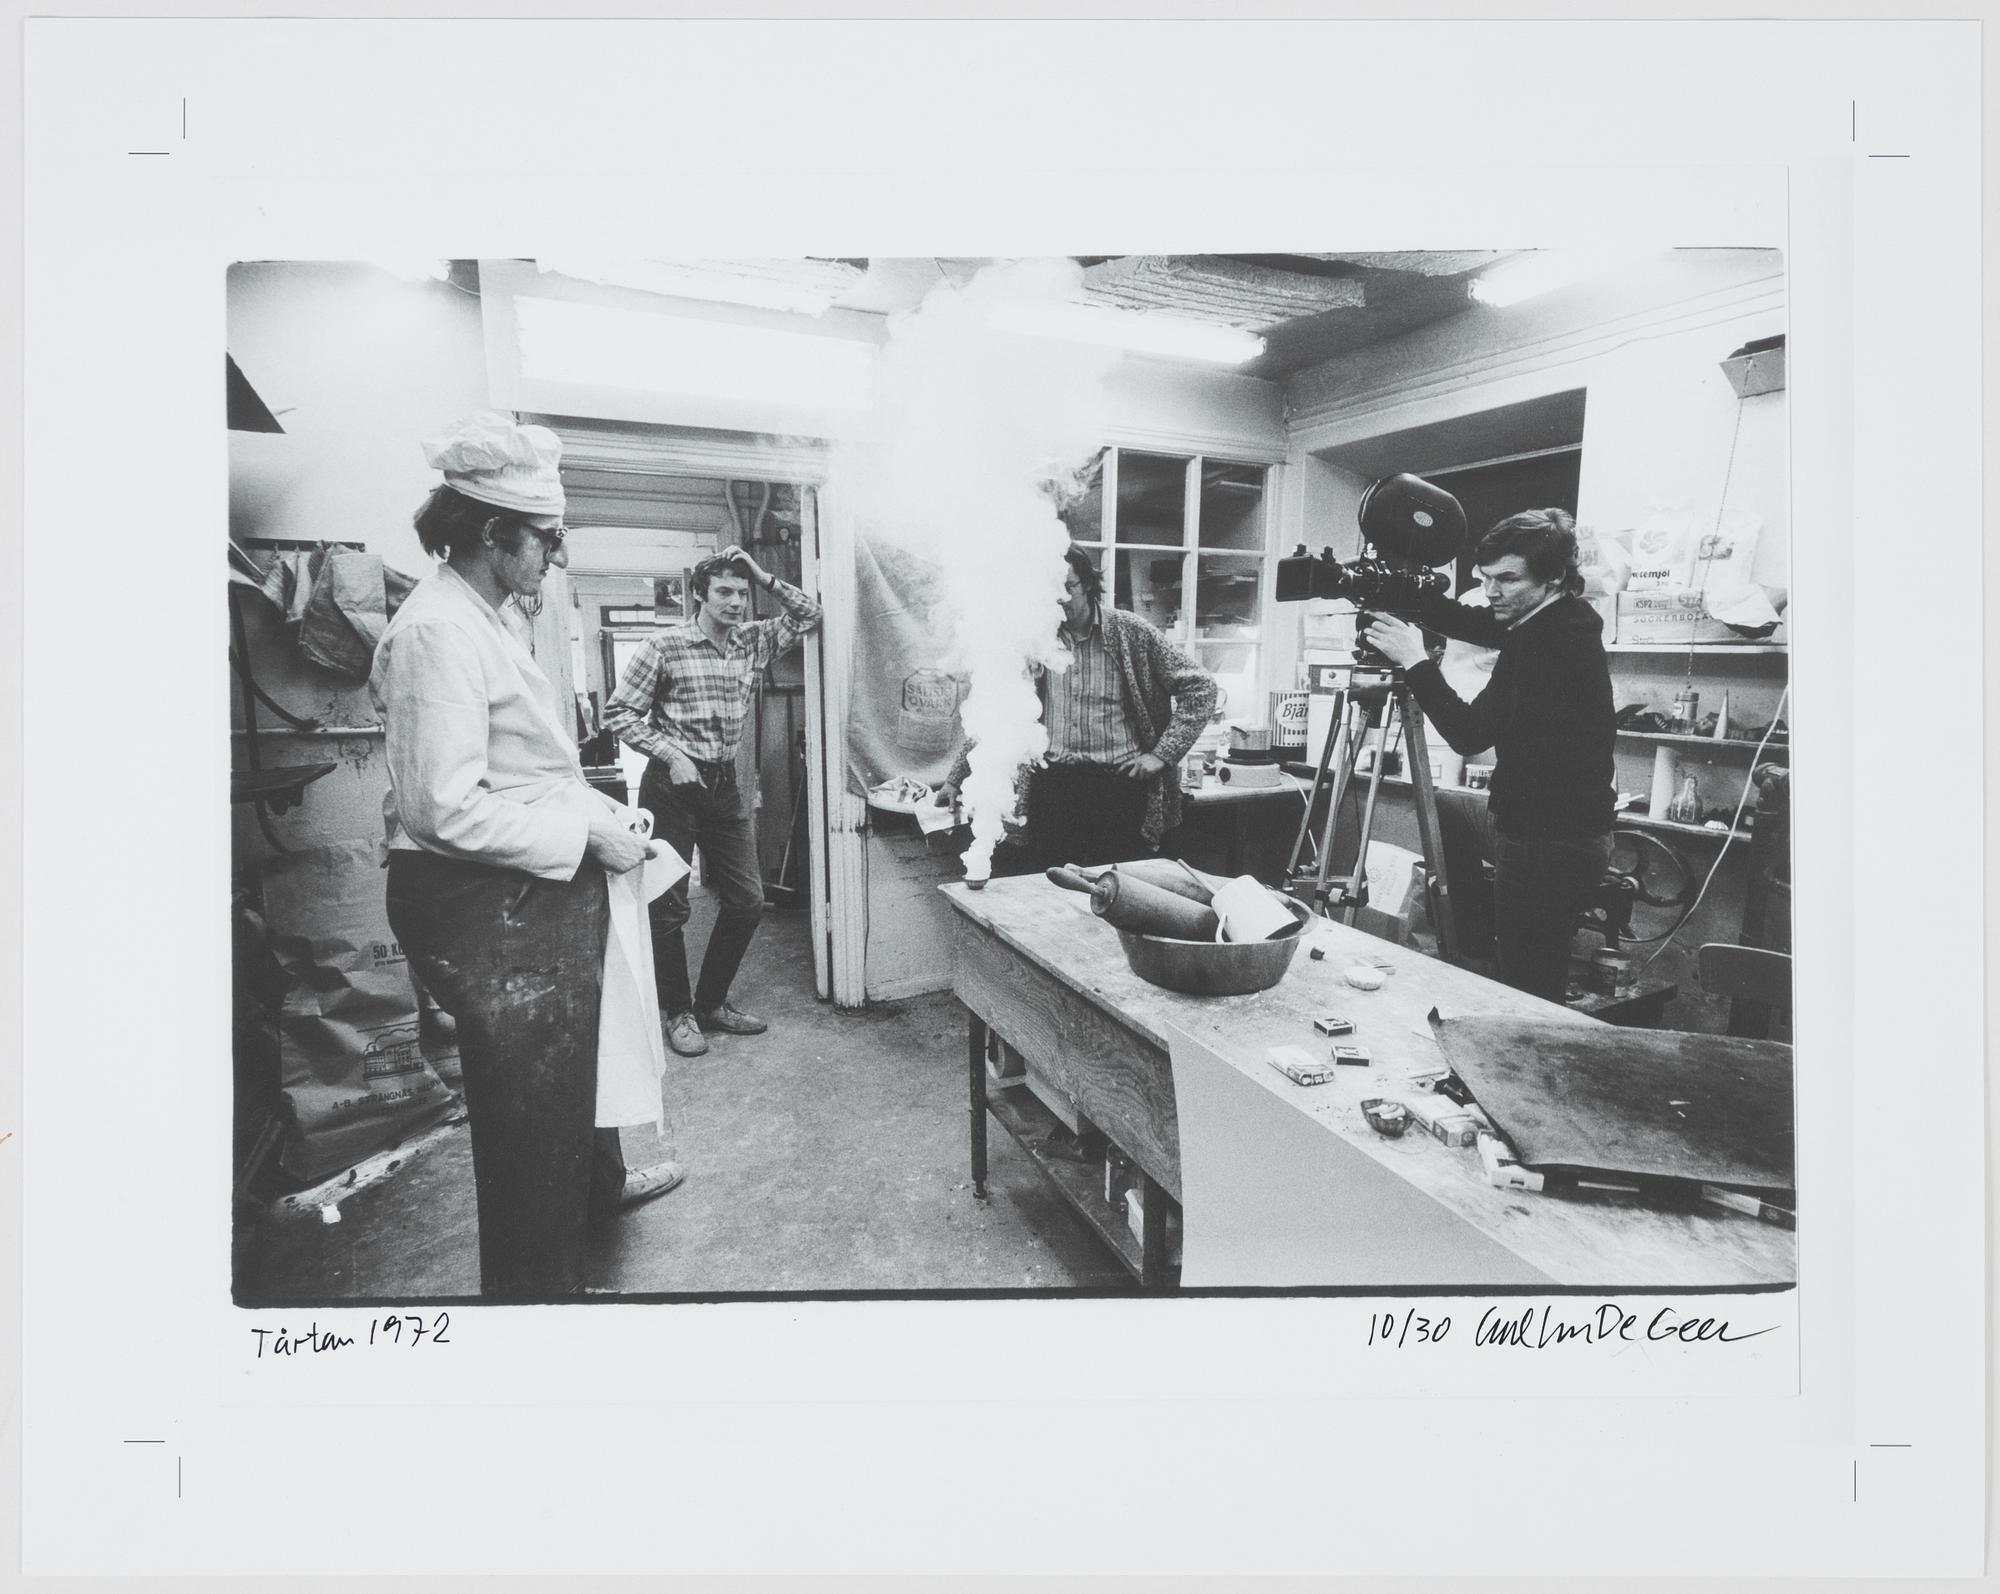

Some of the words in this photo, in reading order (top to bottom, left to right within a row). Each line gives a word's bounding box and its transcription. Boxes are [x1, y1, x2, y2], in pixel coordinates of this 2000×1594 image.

[1632, 611, 1714, 624] SOCKERBOLA
[373, 944, 387, 959] 50
[250, 1321, 355, 1359] Tårtan
[369, 1311, 451, 1348] 1972
[1368, 1307, 1452, 1349] 10/30
[1595, 1303, 1637, 1341] De
[1646, 1307, 1782, 1343] Geer
